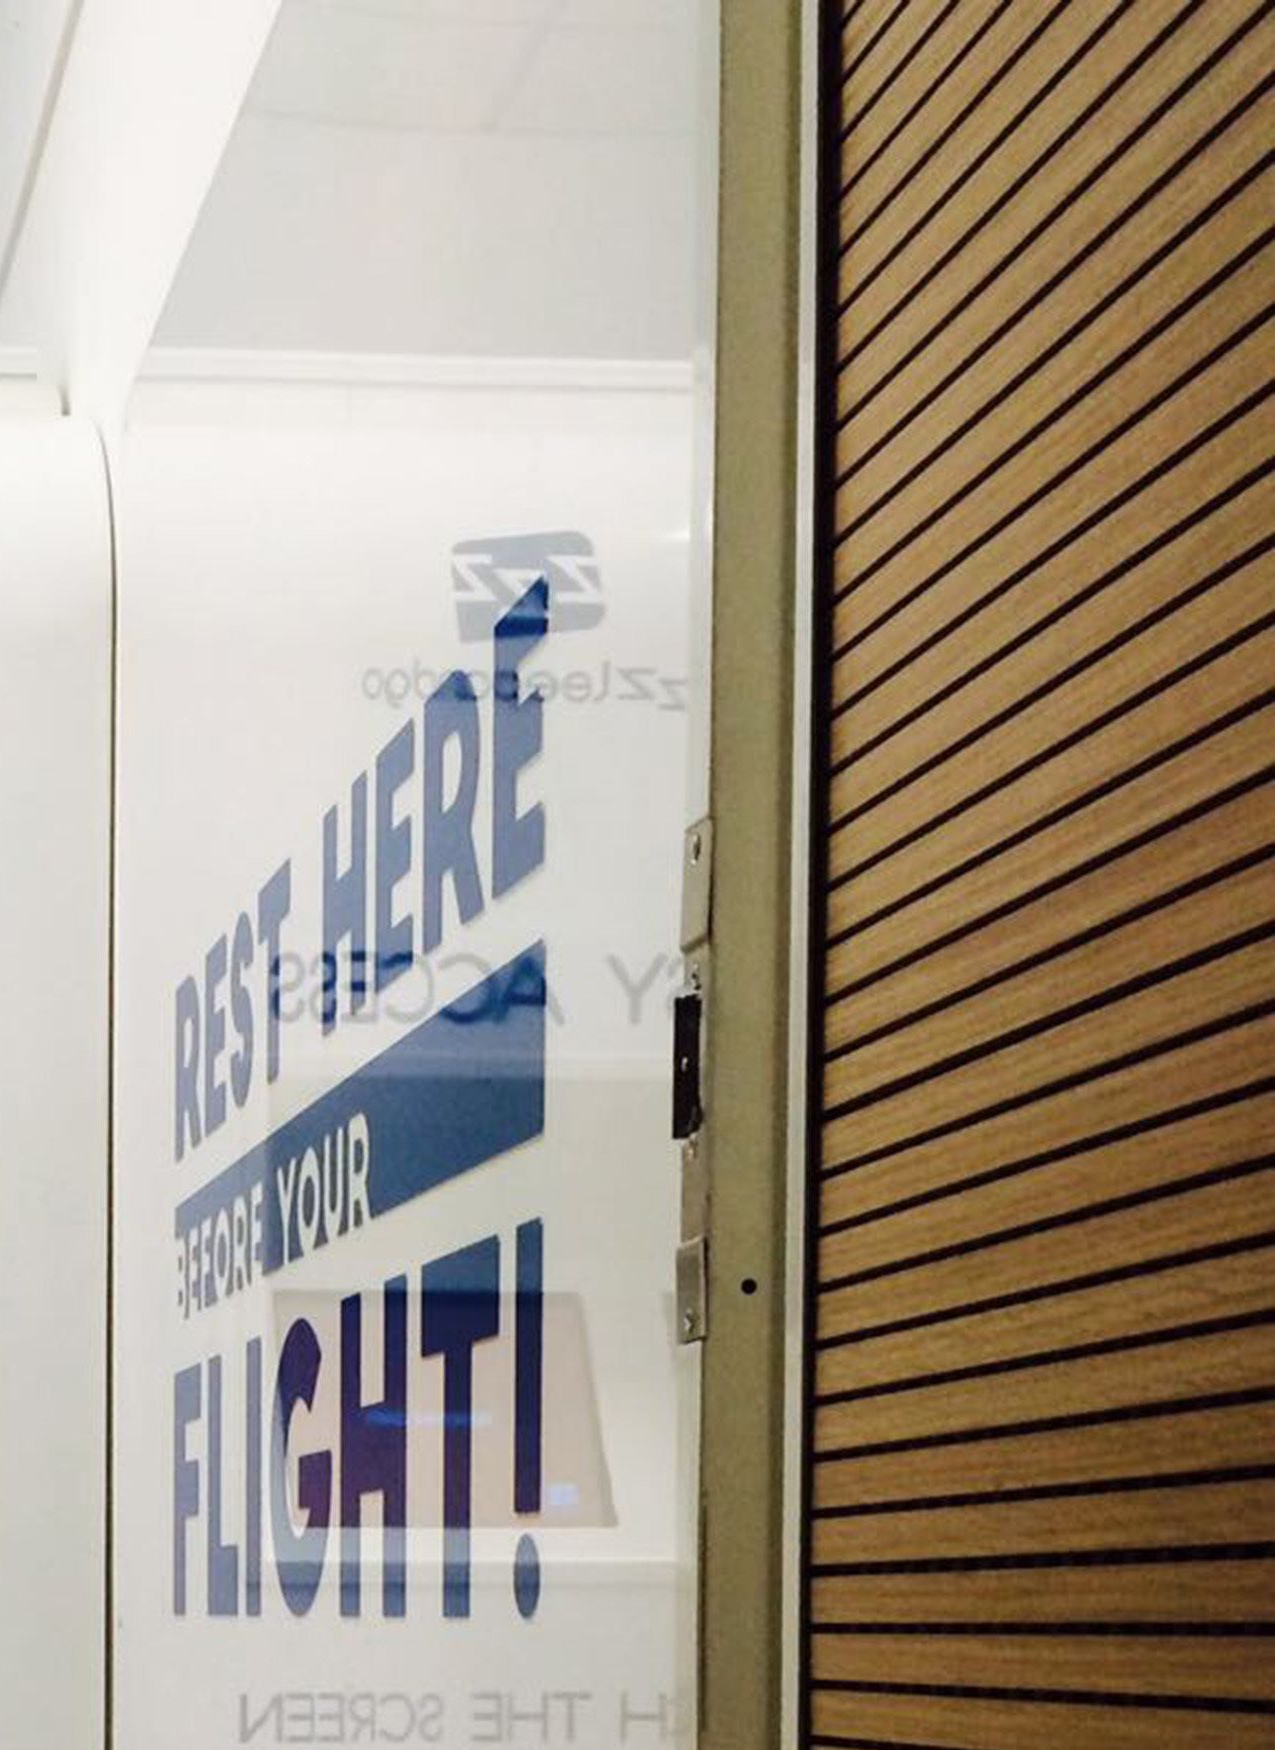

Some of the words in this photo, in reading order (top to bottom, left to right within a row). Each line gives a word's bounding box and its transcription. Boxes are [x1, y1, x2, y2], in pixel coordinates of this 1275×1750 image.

[175, 857, 292, 1164] REST
[321, 573, 549, 1038] HERE
[173, 1216, 544, 1620] FLIGHT!
[174, 1181, 265, 1320] BEFORE
[277, 1112, 372, 1266] YOUR
